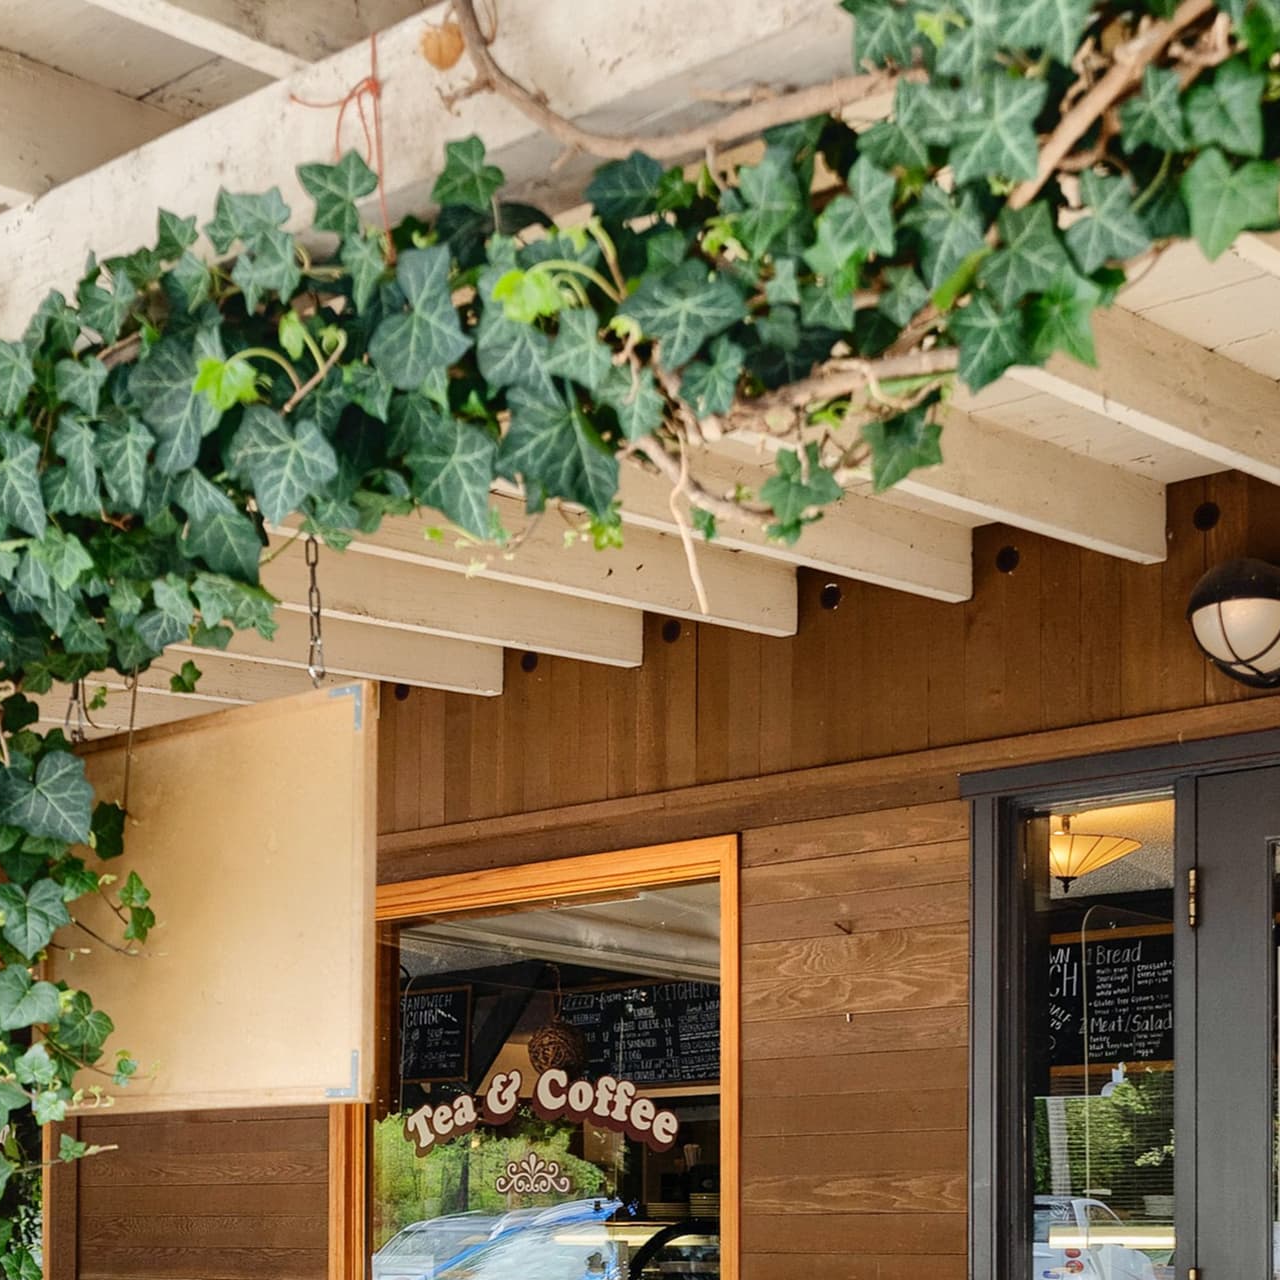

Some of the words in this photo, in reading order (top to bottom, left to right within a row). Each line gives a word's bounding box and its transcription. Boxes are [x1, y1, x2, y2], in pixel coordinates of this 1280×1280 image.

[1096, 940, 1142, 966] Bread
[653, 982, 712, 1001] KITCHEN
[406, 1094, 477, 1149] Tea
[486, 1069, 521, 1115] &
[536, 1068, 679, 1145] Coffee
